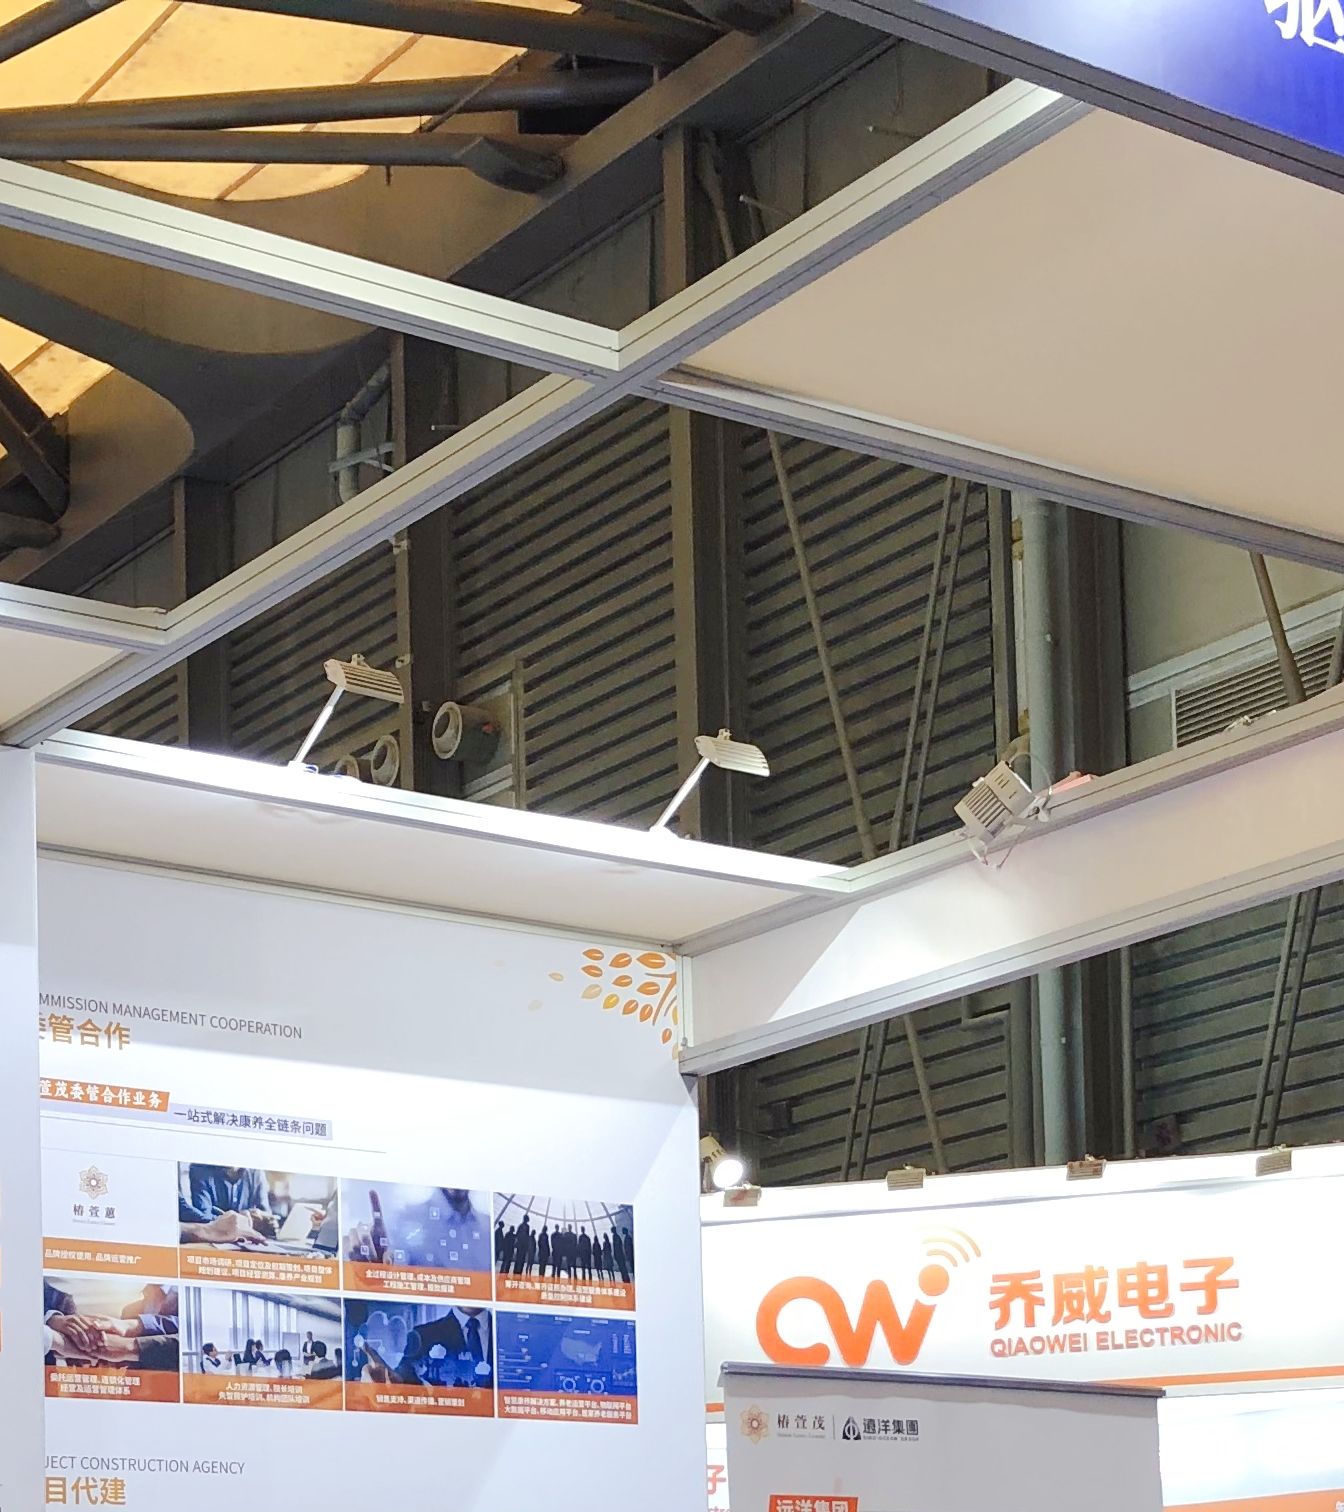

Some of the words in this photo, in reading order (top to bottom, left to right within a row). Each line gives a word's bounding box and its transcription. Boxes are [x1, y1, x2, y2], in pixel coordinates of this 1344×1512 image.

[112, 1002, 206, 1027] MANAGEMENT
[209, 1015, 303, 1040] COOPERATION
[173, 1107, 328, 1138] 一站式解决康养全链条问题
[989, 1256, 1240, 1331] 乔威电子
[989, 1331, 1090, 1358] QIAOWEI
[1096, 1321, 1243, 1352] ELECTRONIC
[777, 1413, 826, 1431] 椿萱茂
[80, 1456, 189, 1473] CONSTRUCTION
[192, 1460, 246, 1475] AGENCY
[45, 1475, 127, 1506] 目代建
